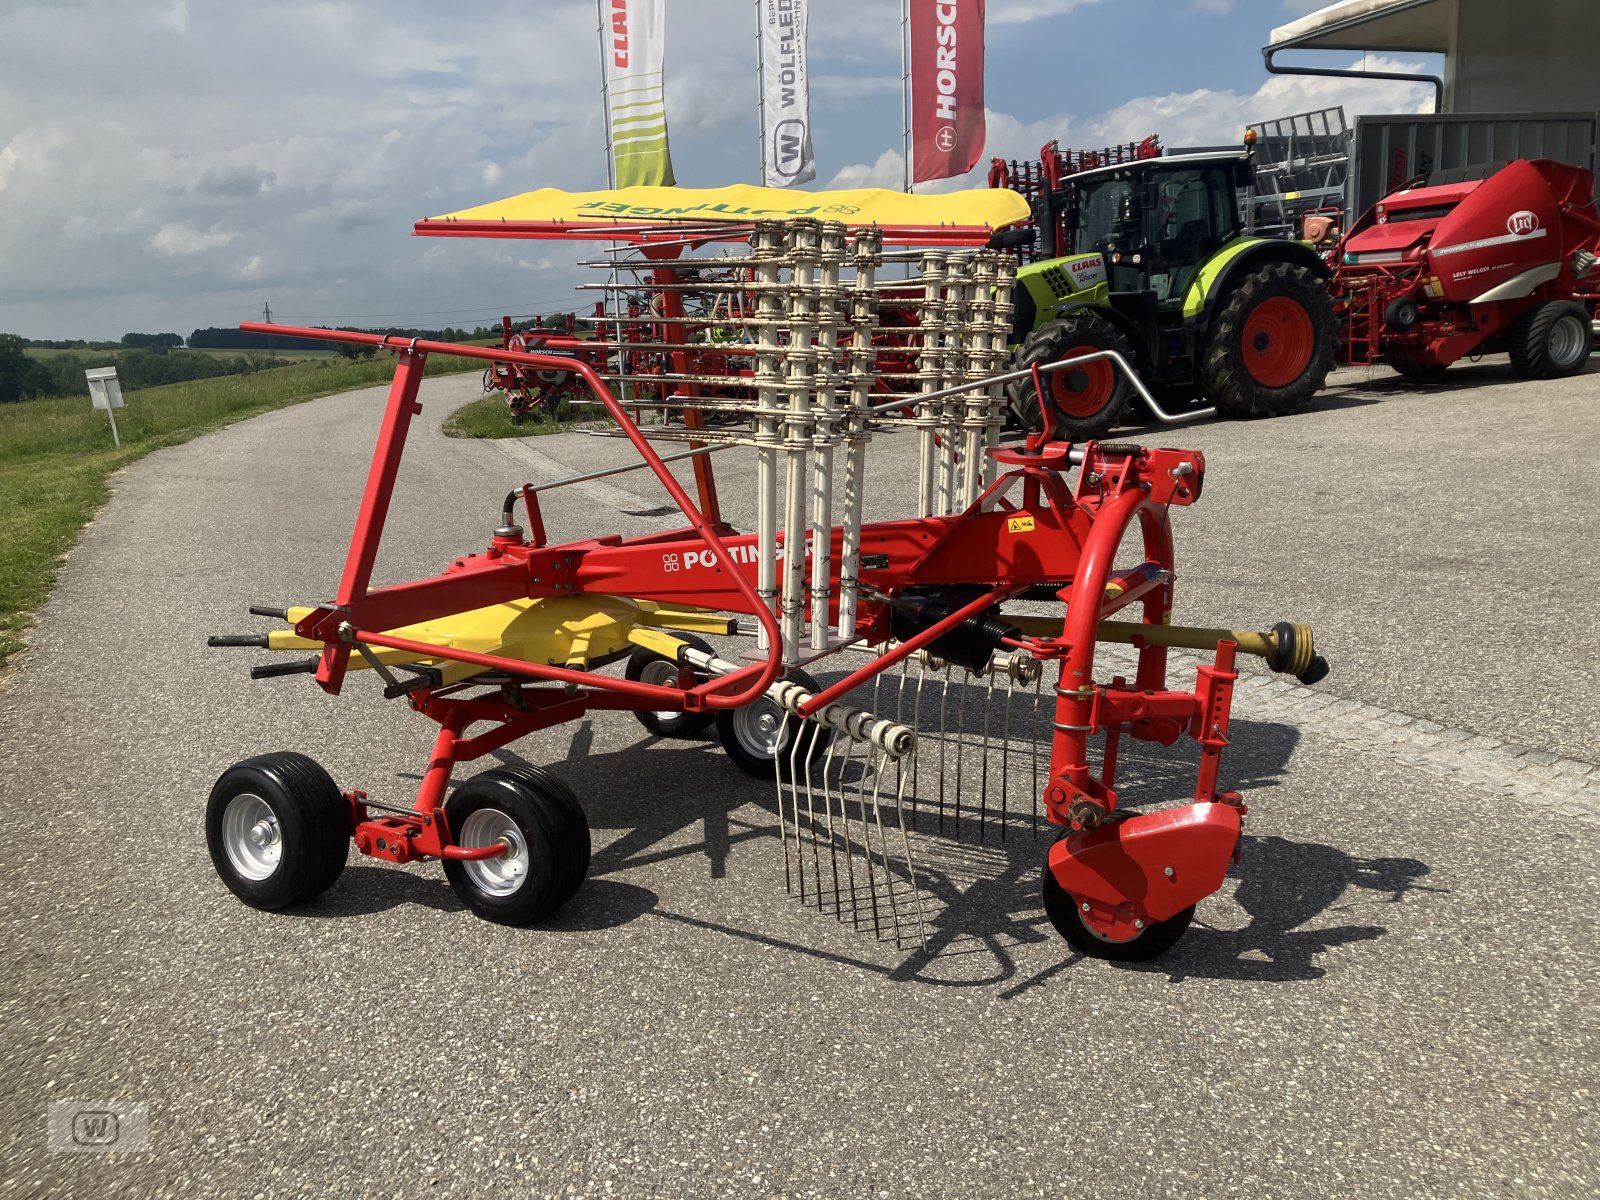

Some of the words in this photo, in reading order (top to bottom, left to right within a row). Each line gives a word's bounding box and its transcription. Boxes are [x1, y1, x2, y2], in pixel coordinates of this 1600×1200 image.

[936, 0, 957, 120] HORSC
[1512, 213, 1532, 233] LELY
[1072, 258, 1101, 272] CLAAS
